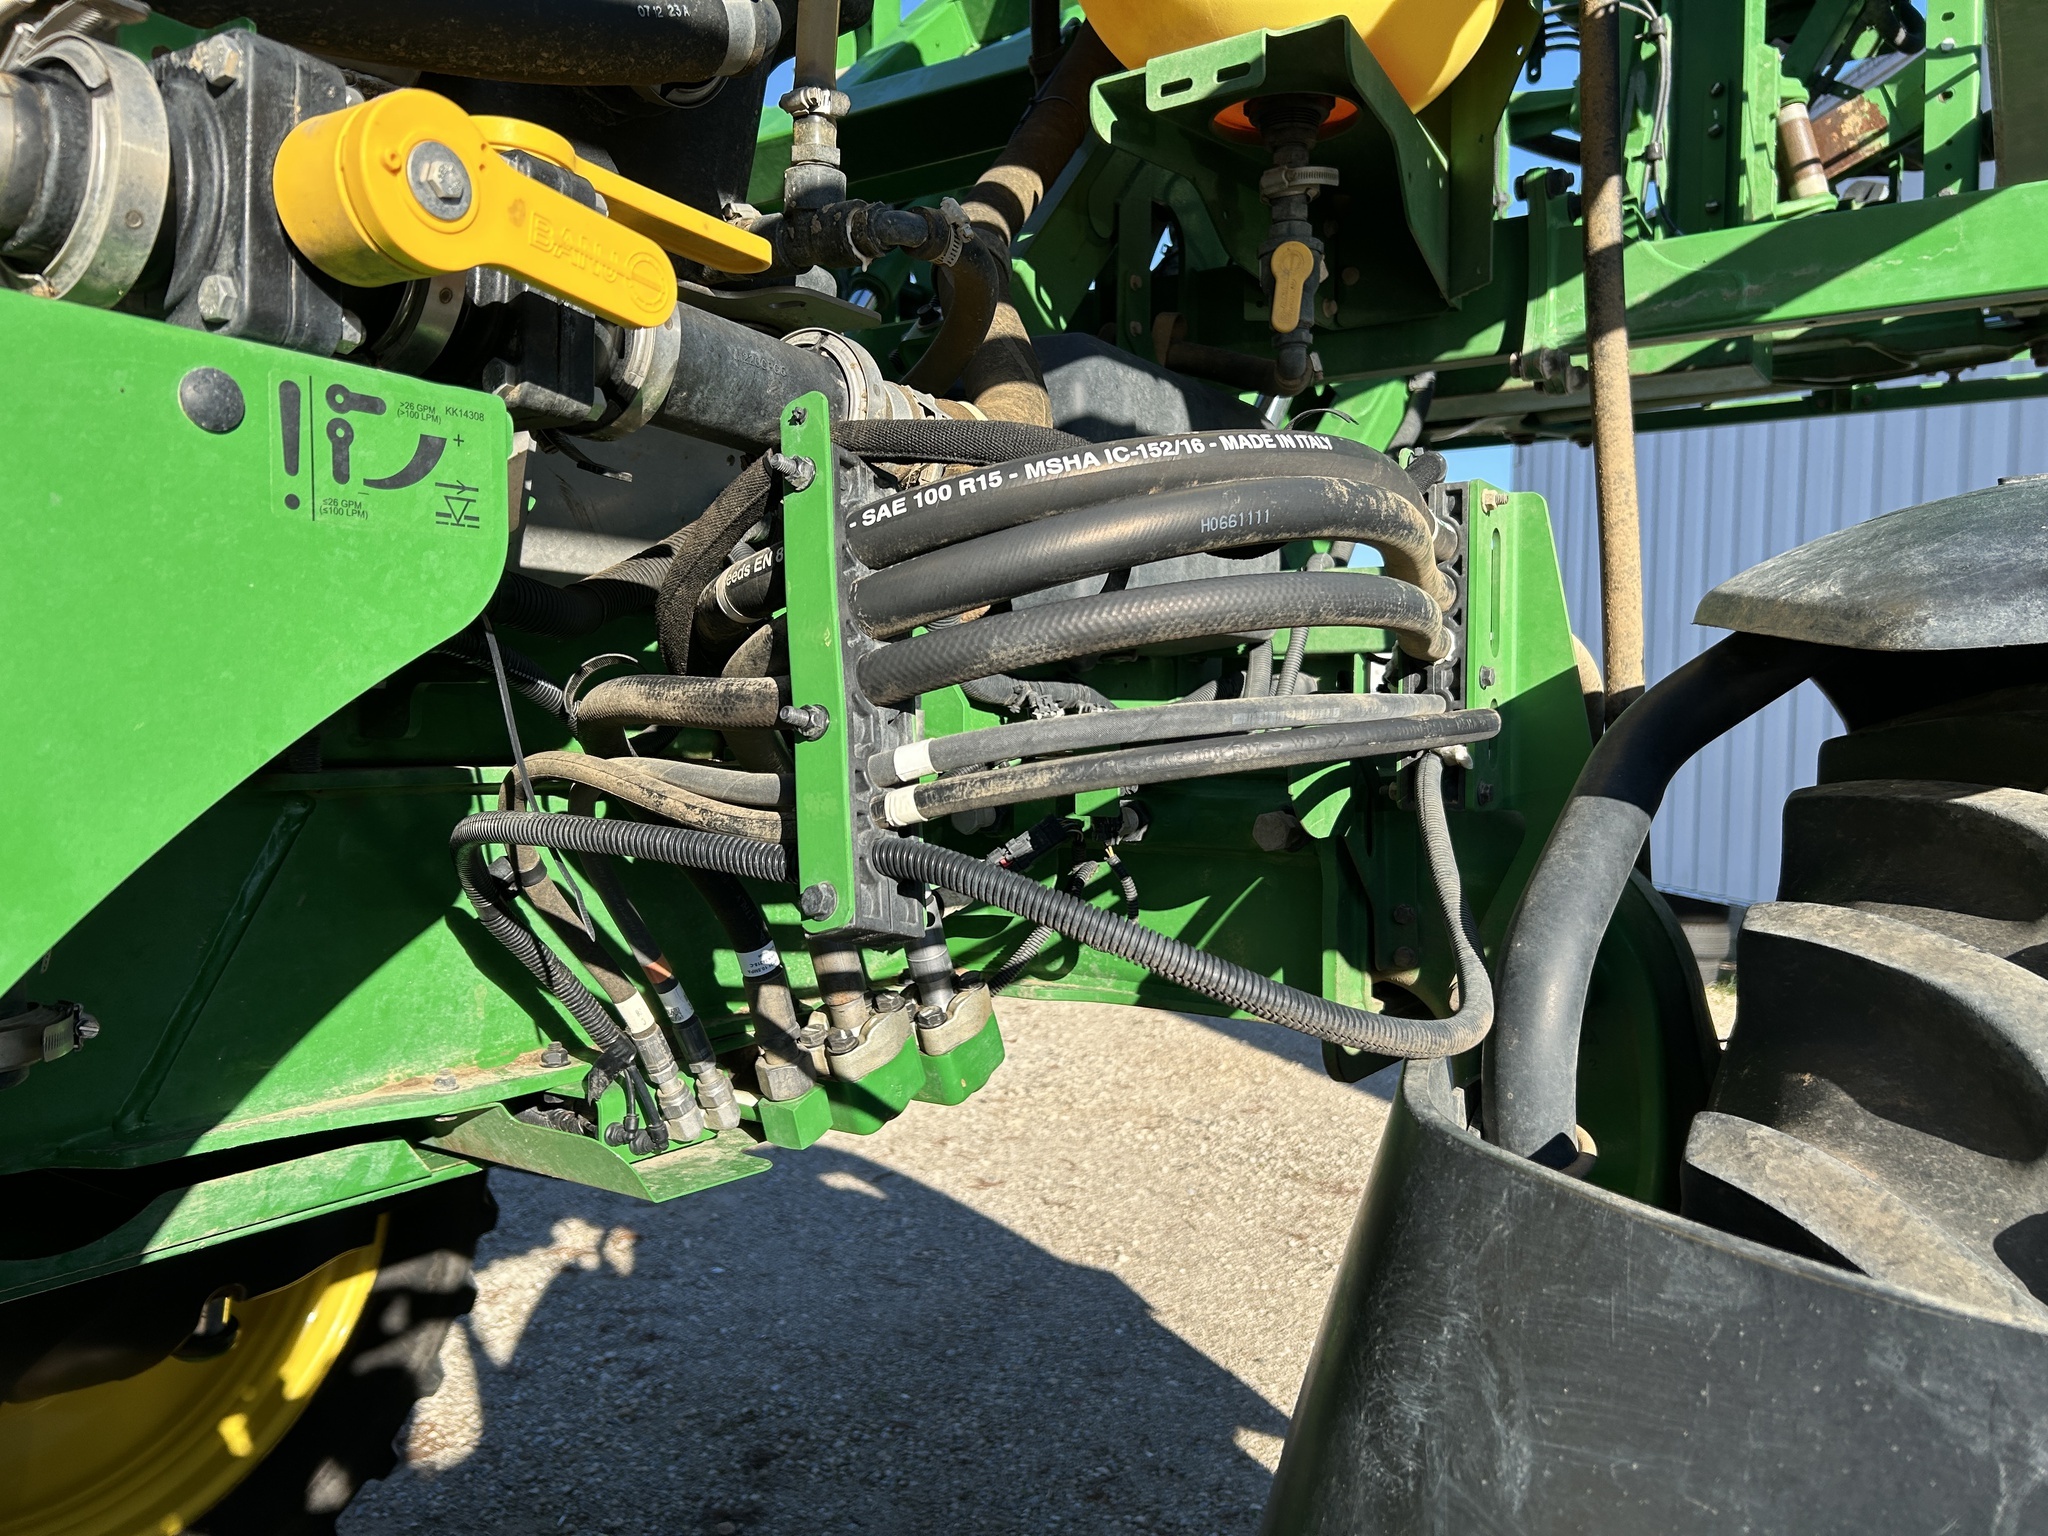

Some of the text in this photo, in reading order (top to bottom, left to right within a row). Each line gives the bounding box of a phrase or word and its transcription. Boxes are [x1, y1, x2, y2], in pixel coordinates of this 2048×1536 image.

[397, 408, 442, 425] (>100 LPM)
[416, 403, 436, 414] GPM
[445, 406, 485, 422] KK14308
[861, 497, 908, 527] SAE
[912, 484, 953, 508] 100
[958, 470, 1003, 496] R15
[1024, 453, 1100, 481] MSHA
[1103, 437, 1206, 465] IC-152/16
[1218, 434, 1276, 451] MADE
[1274, 433, 1297, 449] IN
[1293, 433, 1334, 451] ITALY
[341, 499, 362, 510] GPM
[346, 508, 369, 520] LPM)
[1200, 508, 1270, 533] H0661111
[753, 550, 773, 573] EN
